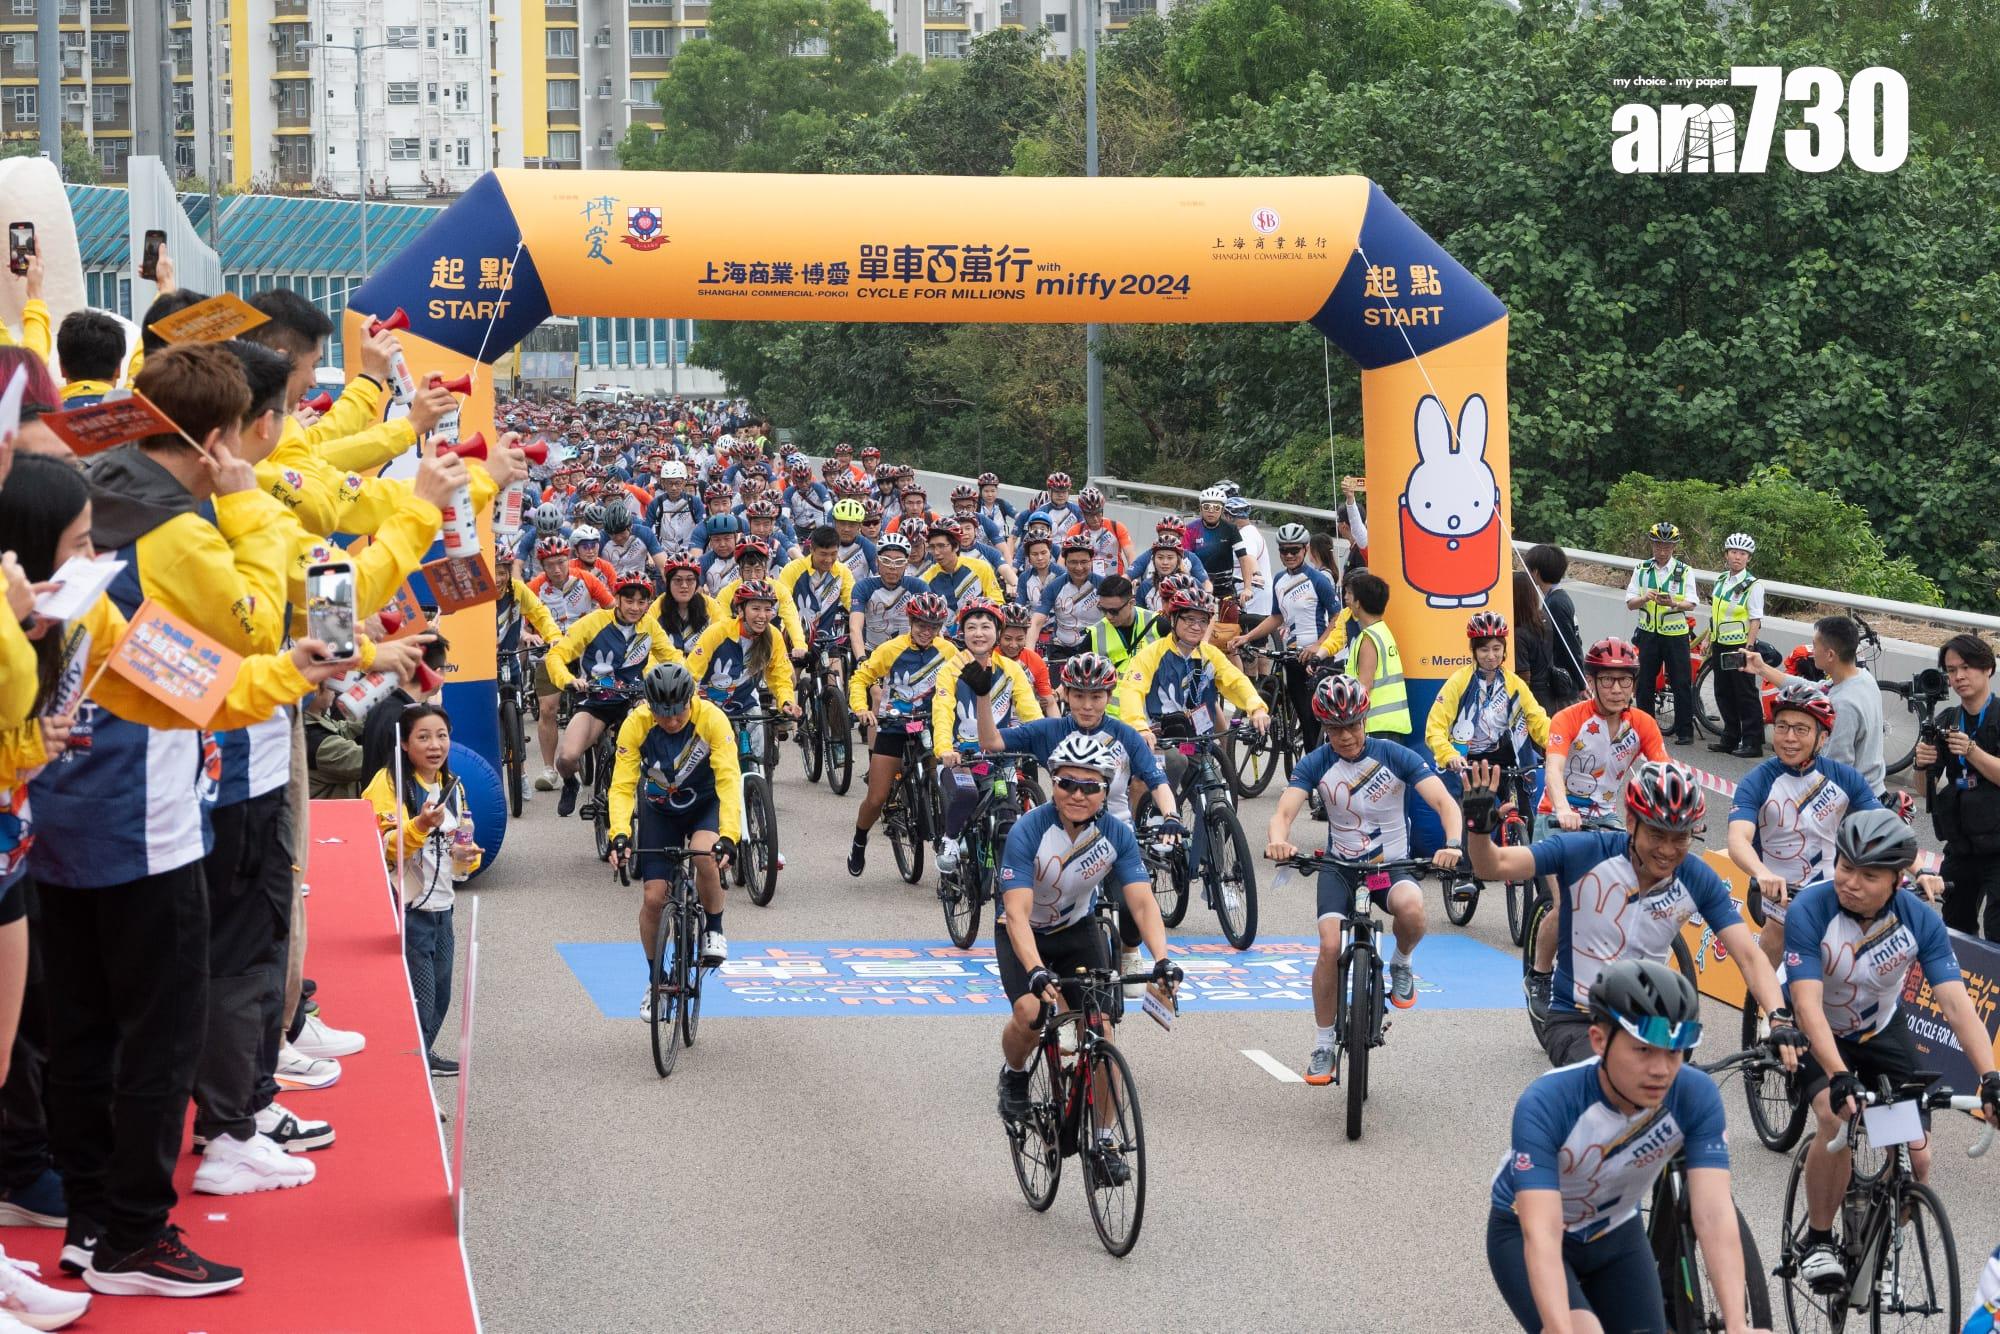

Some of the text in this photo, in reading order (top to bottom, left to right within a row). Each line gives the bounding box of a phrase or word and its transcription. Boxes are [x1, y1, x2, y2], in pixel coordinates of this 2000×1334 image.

[1211, 236, 1328, 250] 上海商業銀行
[857, 244, 1033, 284] 單車百萬行
[1037, 262, 1061, 272] with
[1211, 252, 1328, 261] SHANGHAI COMMERCIAL BANK
[429, 256, 513, 291] 起點
[1363, 264, 1442, 298] 起點
[697, 289, 748, 298] SHANGHAI
[857, 287, 909, 300] CYCLE
[914, 288, 947, 300] FOR
[951, 289, 1026, 300] MILLIONS
[1036, 272, 1191, 301] miffy 2024
[428, 299, 512, 320] START
[1363, 306, 1445, 327] START
[629, 643, 648, 662] miffy
[1366, 768, 1391, 796] miffy
[1370, 783, 1390, 803] 2024
[1812, 785, 1838, 813] miffy
[1080, 841, 1111, 870] miffy
[1081, 857, 1106, 881] 2024
[1651, 906, 1676, 921] 202
[1873, 931, 1911, 966] miffy
[1876, 950, 1908, 977] 2024
[730, 985, 943, 995] CYCLE
[743, 995, 828, 1003] with
[1915, 1018, 1937, 1041] CYCLE
[1936, 1025, 1951, 1046] FOR
